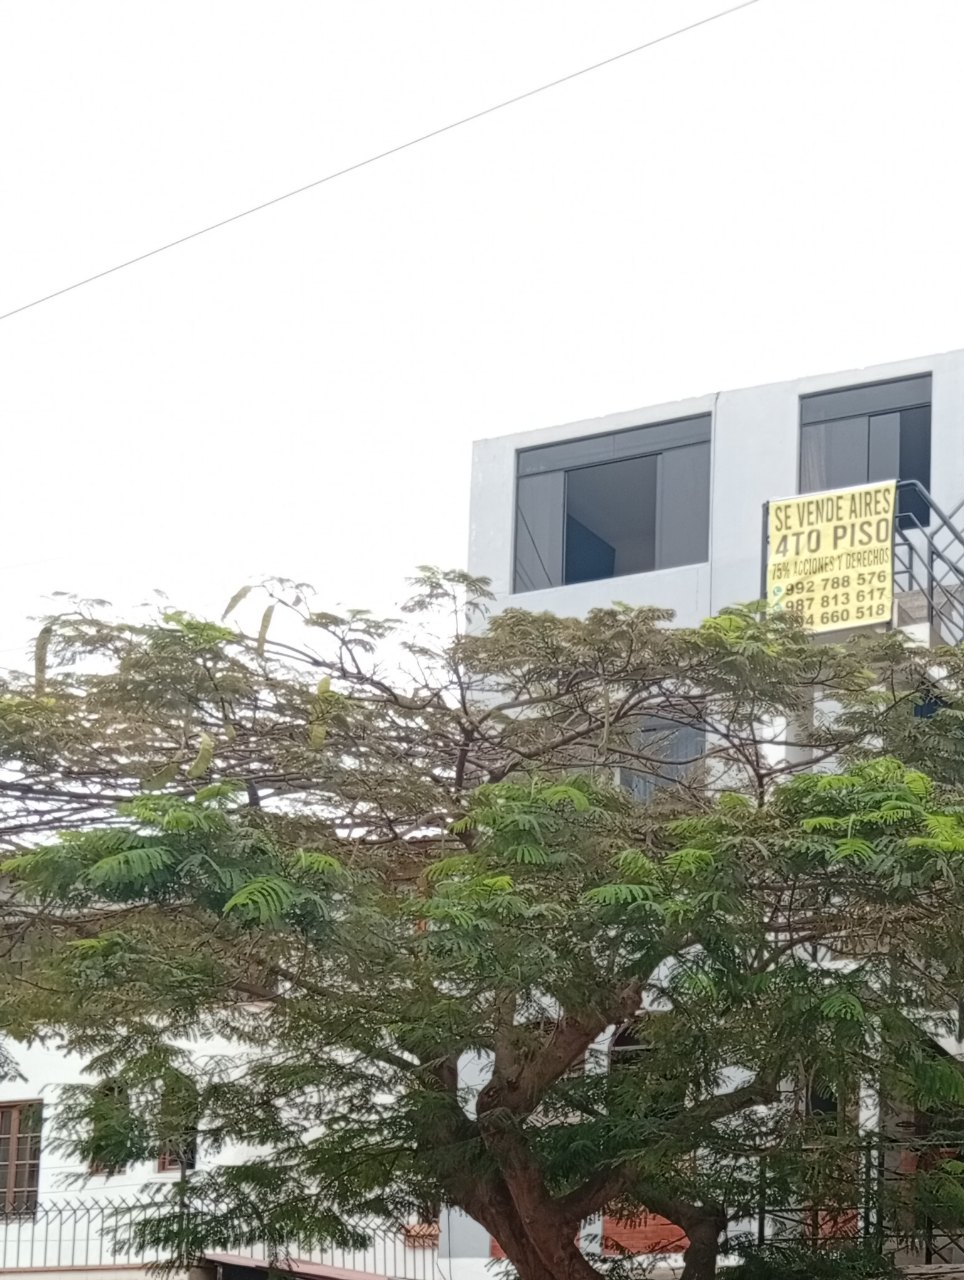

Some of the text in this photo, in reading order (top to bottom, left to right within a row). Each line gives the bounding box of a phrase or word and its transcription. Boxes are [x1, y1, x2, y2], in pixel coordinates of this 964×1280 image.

[775, 488, 891, 532] SE VENDE AIRES
[775, 518, 889, 557] 4TO PISO
[772, 547, 889, 581] 75% ACCIONES Y DERECHOS
[785, 570, 886, 596] 992 788 576
[785, 588, 886, 613] 987 813 617
[820, 609, 850, 625] 660
[856, 604, 885, 619] 518
